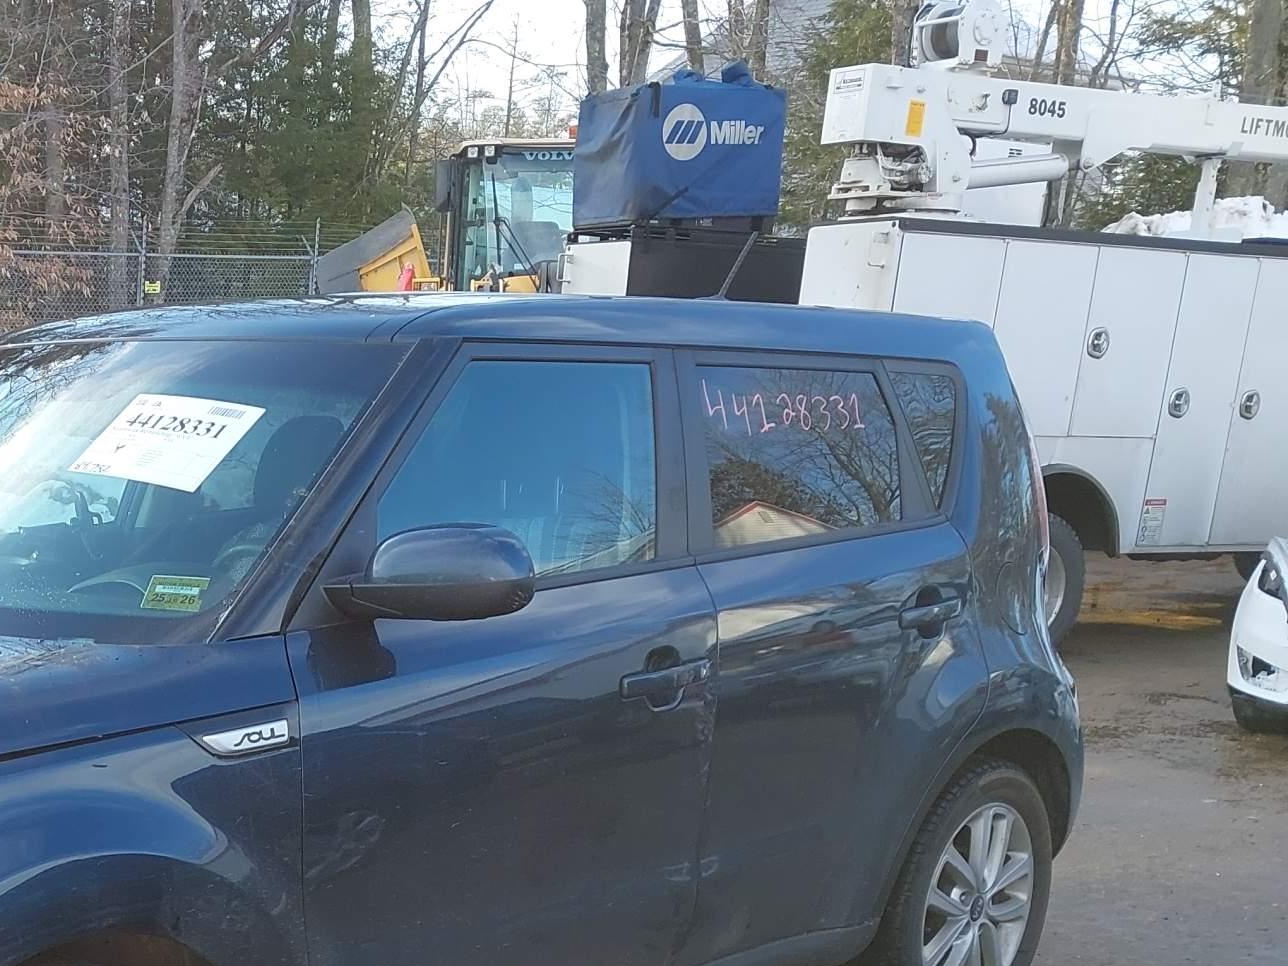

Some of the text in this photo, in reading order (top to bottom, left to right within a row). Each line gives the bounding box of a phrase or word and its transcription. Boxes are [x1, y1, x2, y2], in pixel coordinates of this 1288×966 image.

[1028, 98, 1066, 118] 8045
[711, 120, 764, 145] Miller
[520, 151, 574, 160] VOLV
[702, 379, 865, 436] 44128331
[127, 412, 227, 439] 44128331
[234, 728, 285, 747] SOUL
